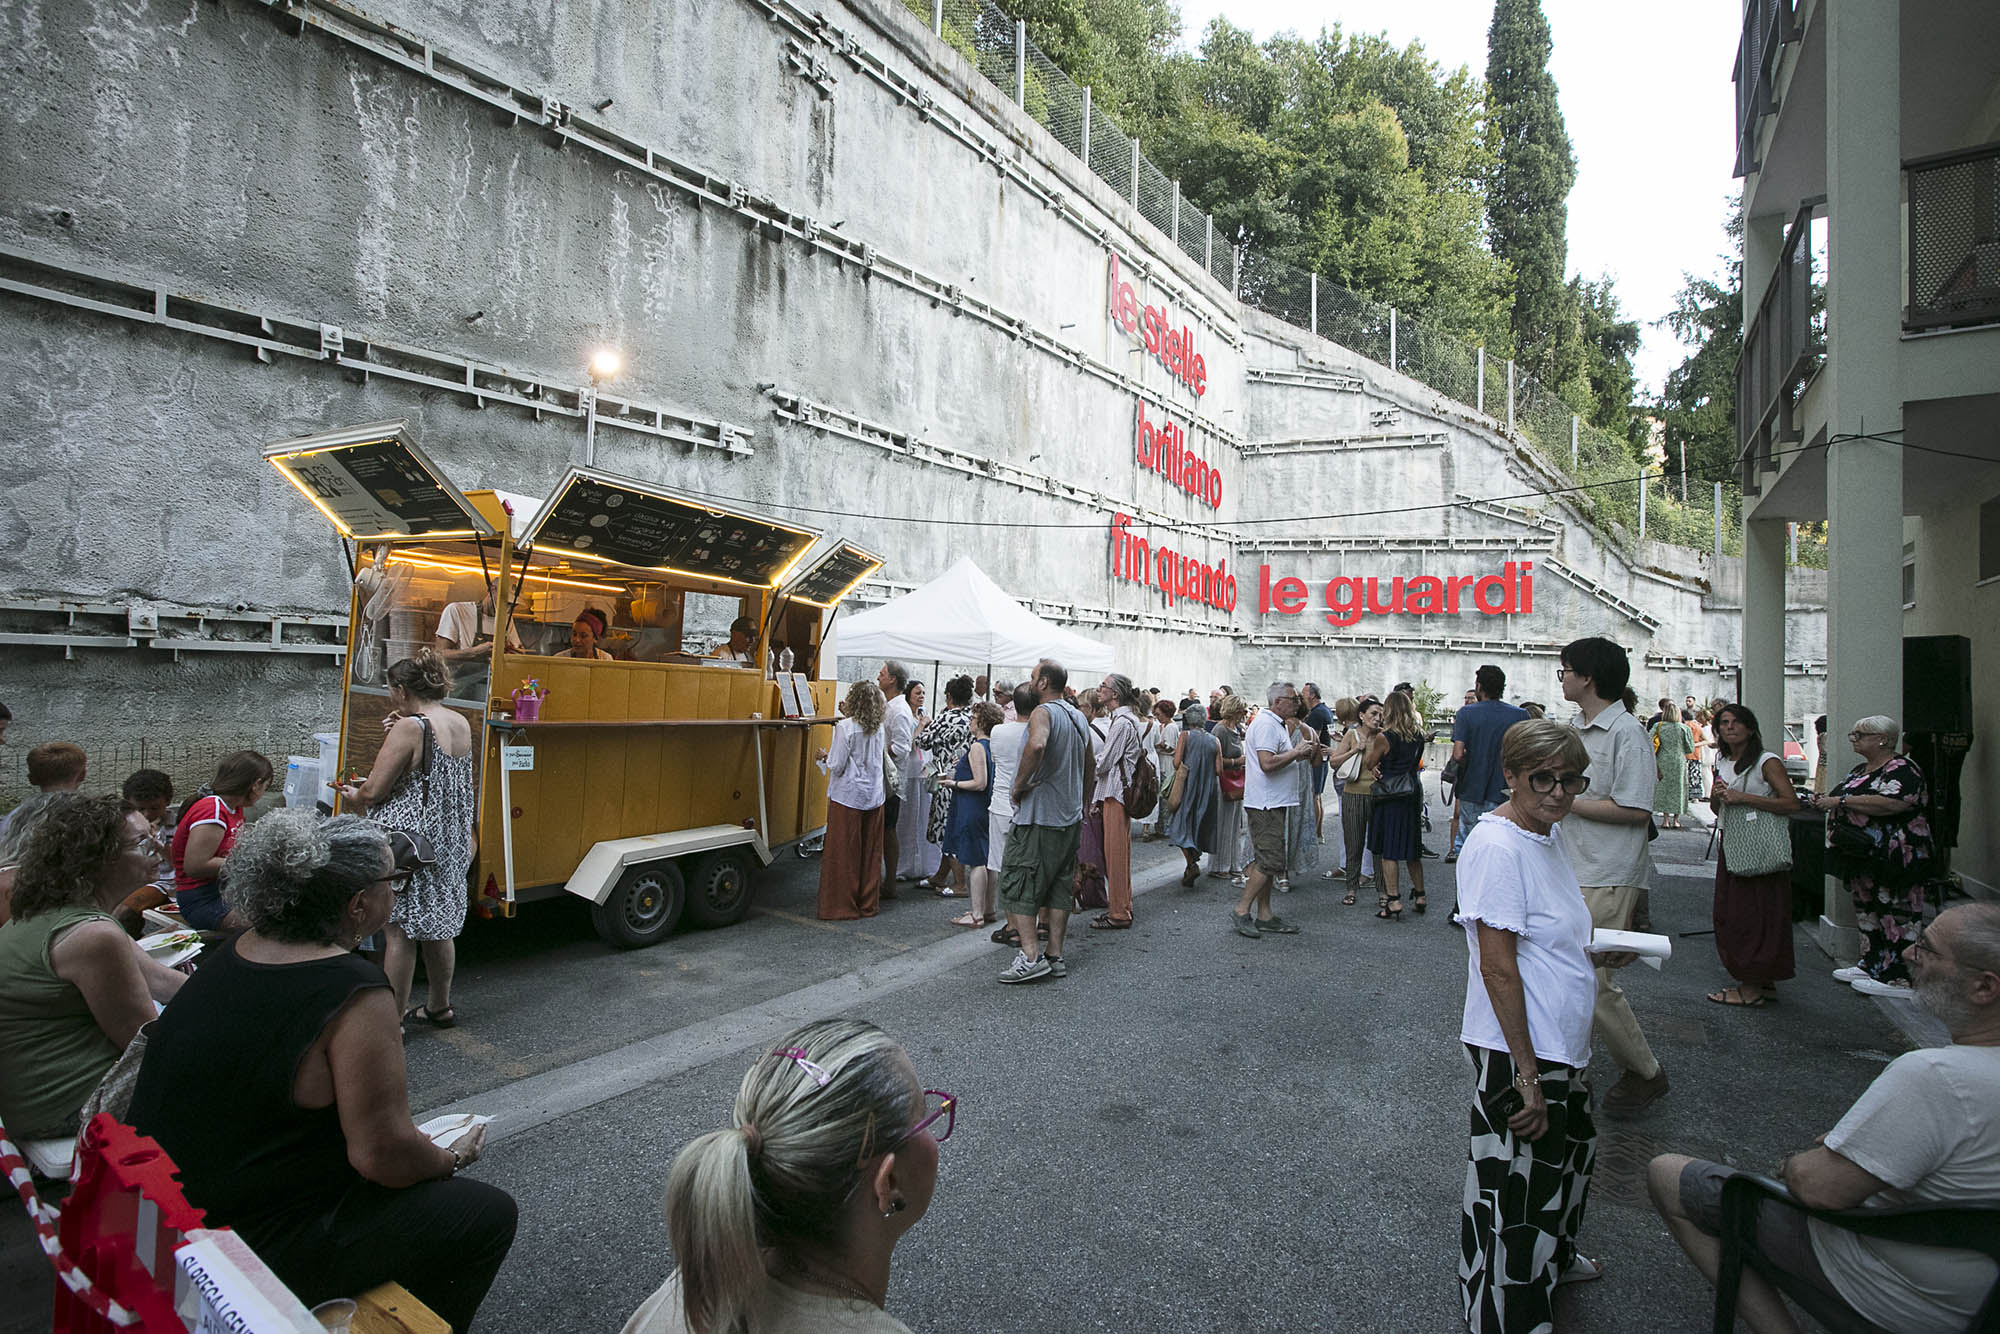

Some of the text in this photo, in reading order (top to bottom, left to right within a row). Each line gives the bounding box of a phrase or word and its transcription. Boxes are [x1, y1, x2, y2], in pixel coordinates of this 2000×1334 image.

[1111, 253, 1208, 396] le stelle
[1137, 399, 1222, 510] brillano
[1111, 511, 1238, 613] fin quando
[1258, 560, 1534, 628] le guardi
